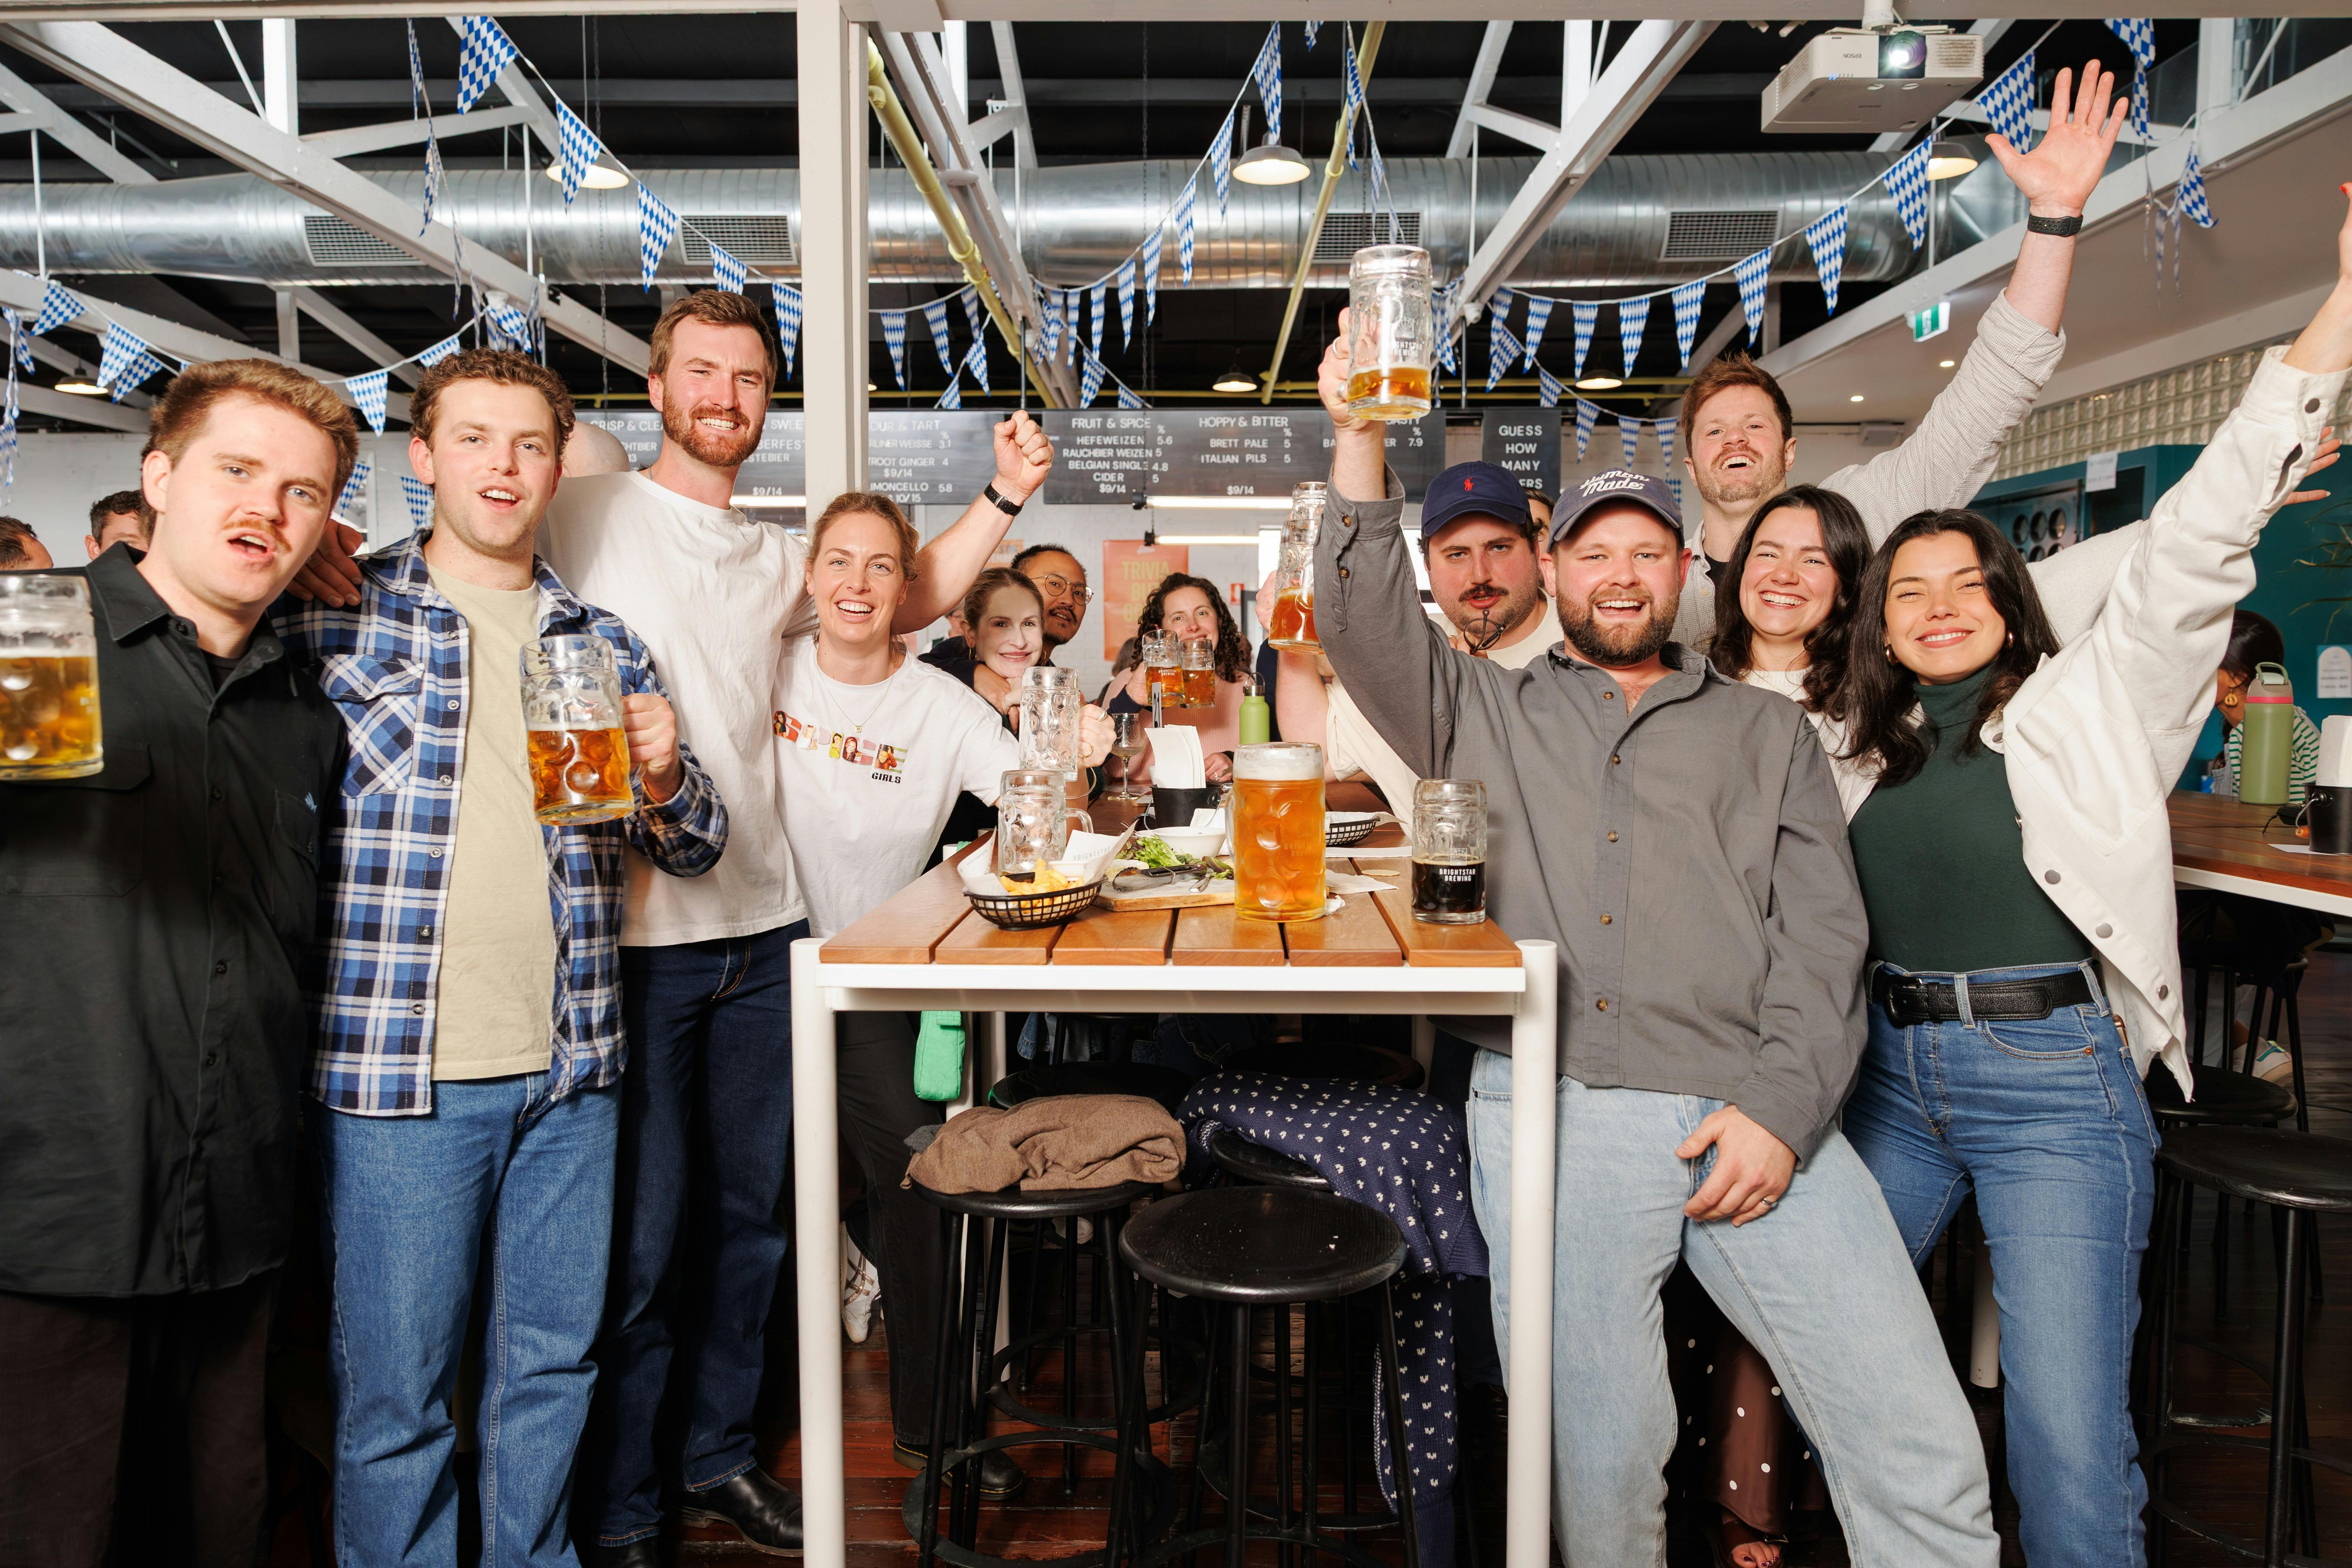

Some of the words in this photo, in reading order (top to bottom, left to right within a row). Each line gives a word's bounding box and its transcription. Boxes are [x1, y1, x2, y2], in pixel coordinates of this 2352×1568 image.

[627, 421, 636, 431] &
[912, 419, 940, 430] TART
[1072, 418, 1103, 429] FRUIT
[1106, 418, 1117, 429] &
[1120, 418, 1151, 429] SPICE
[1199, 417, 1236, 428] HOPPY
[1238, 416, 1248, 427] &
[1251, 416, 1288, 427] BITTER
[1156, 424, 1165, 434] %
[1283, 428, 1292, 437] %
[1412, 426, 1422, 436] %
[1499, 425, 1543, 436] GUESS
[1077, 435, 1145, 445] HEFEWEIZEN
[1156, 435, 1173, 445] 5.6
[1210, 439, 1239, 448] BRETT
[1244, 439, 1268, 448] PALE
[1284, 439, 1291, 448] 5
[1408, 437, 1423, 447] 7.9
[1063, 448, 1114, 458] RAUCHBIER
[1116, 448, 1153, 458] WEIZEN
[1155, 448, 1163, 457] 5
[1506, 442, 1537, 454] HOW
[899, 457, 935, 466] GINGER
[942, 458, 949, 466] 4
[1201, 454, 1239, 463] ITALIAN
[1245, 454, 1267, 463] PILS
[1284, 454, 1291, 463] 5
[1068, 460, 1110, 470] BELGIAN
[1112, 460, 1149, 471] SINGLE
[1152, 462, 1169, 471] 4.8
[1501, 460, 1540, 471] MANY
[883, 468, 912, 478] $9/14
[1093, 472, 1124, 482] CIDER
[1152, 474, 1160, 483] 5
[752, 486, 783, 495] $9/14
[1099, 483, 1126, 494] $9/14
[1227, 485, 1255, 495] $9/14
[1582, 478, 1645, 497] Made
[1121, 561, 1170, 580] TRIVIA
[871, 772, 901, 784] GIRLS
